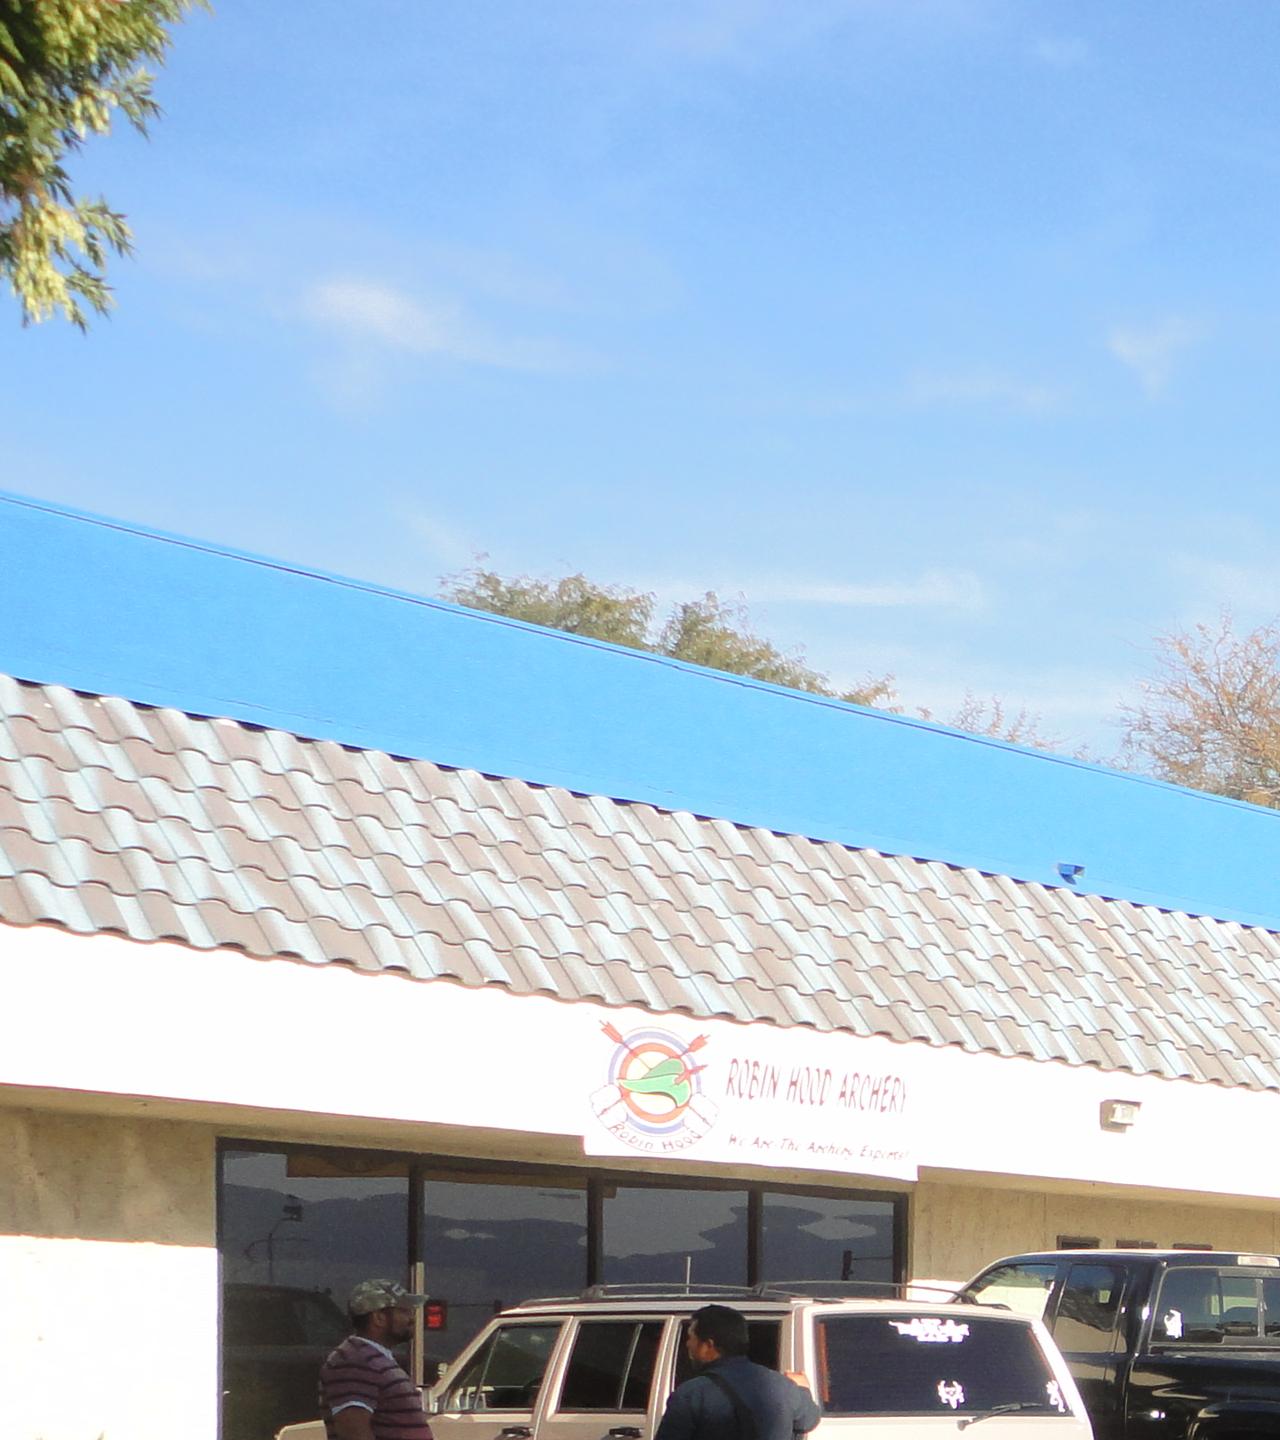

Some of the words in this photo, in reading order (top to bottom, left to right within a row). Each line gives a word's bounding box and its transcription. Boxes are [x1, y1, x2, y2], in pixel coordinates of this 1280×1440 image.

[726, 1058, 781, 1100] ROBIN
[787, 1066, 831, 1106] HOOD
[839, 1072, 906, 1113] ARCHERY
[607, 1121, 654, 1149] Robin
[662, 1129, 703, 1150] Hood
[752, 1136, 774, 1149] Are
[780, 1137, 800, 1151] The
[808, 1141, 852, 1160] Archery
